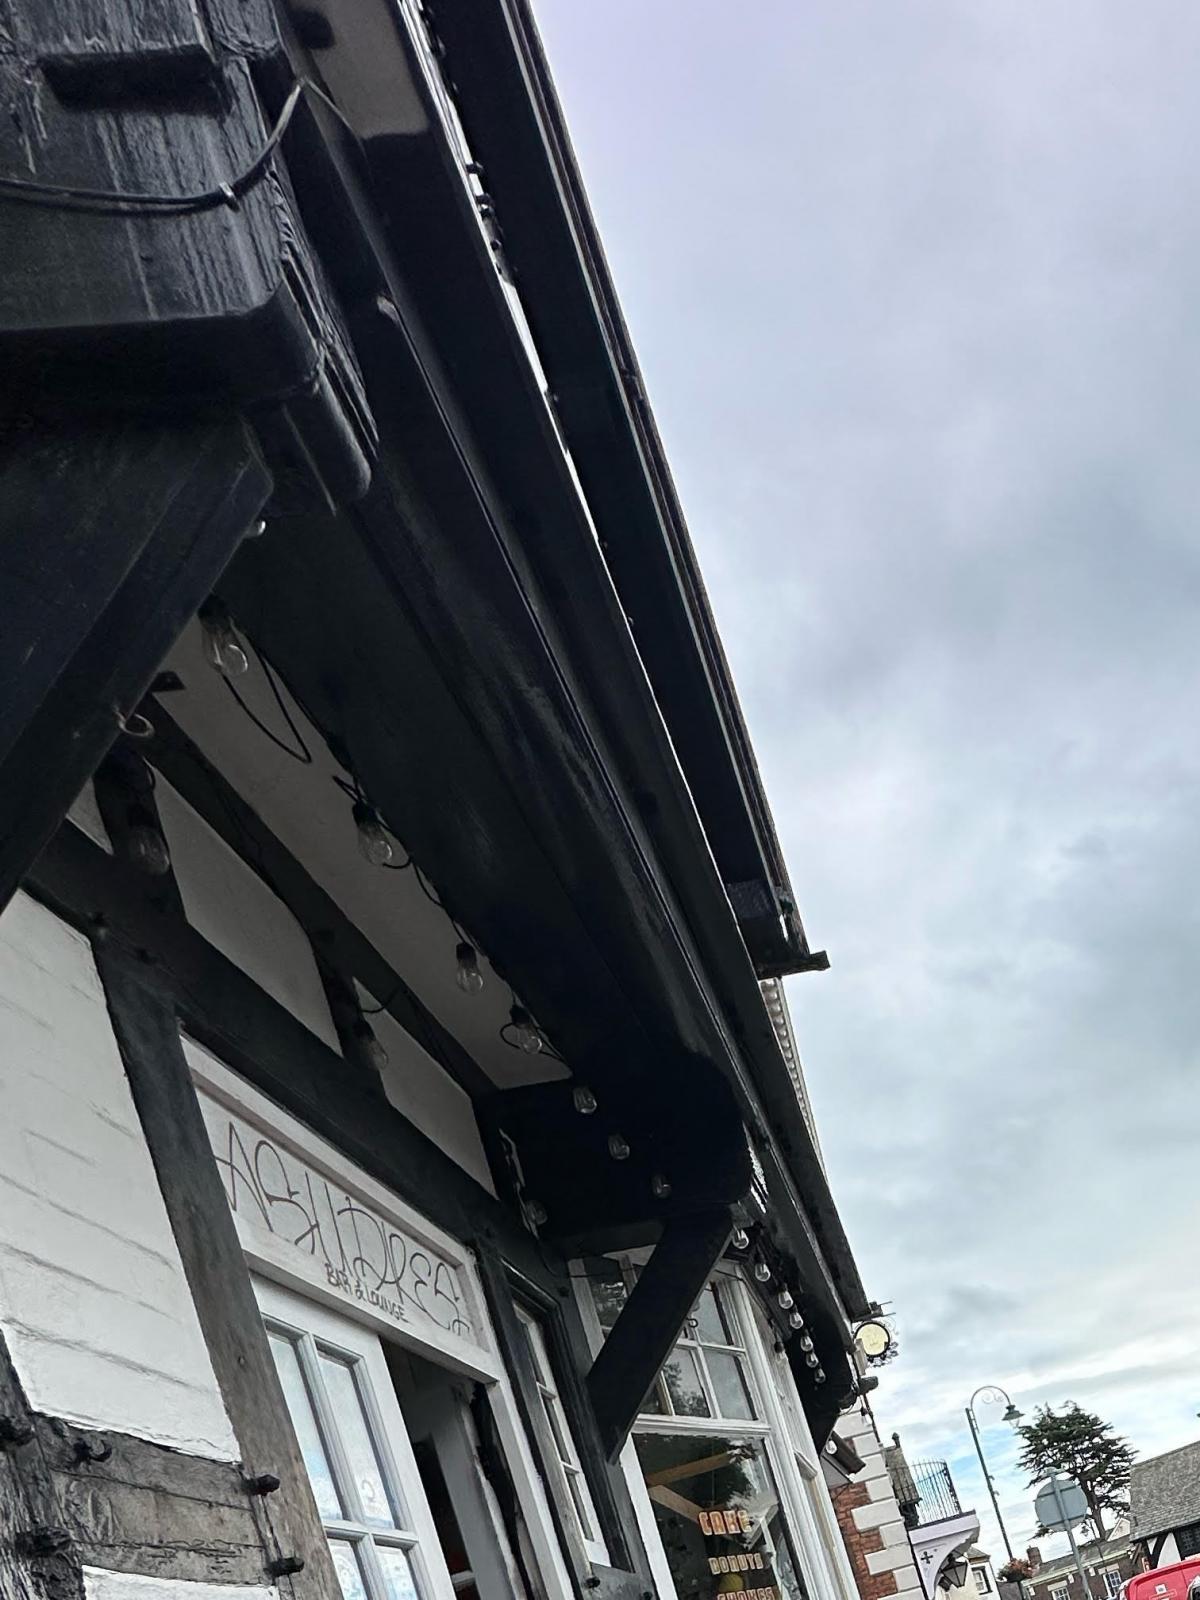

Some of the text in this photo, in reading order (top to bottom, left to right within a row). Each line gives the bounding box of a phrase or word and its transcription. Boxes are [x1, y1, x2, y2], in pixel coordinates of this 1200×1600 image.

[325, 1263, 353, 1295] BAR
[699, 1510, 751, 1535] CAKE
[708, 1552, 764, 1575] DONUTS
